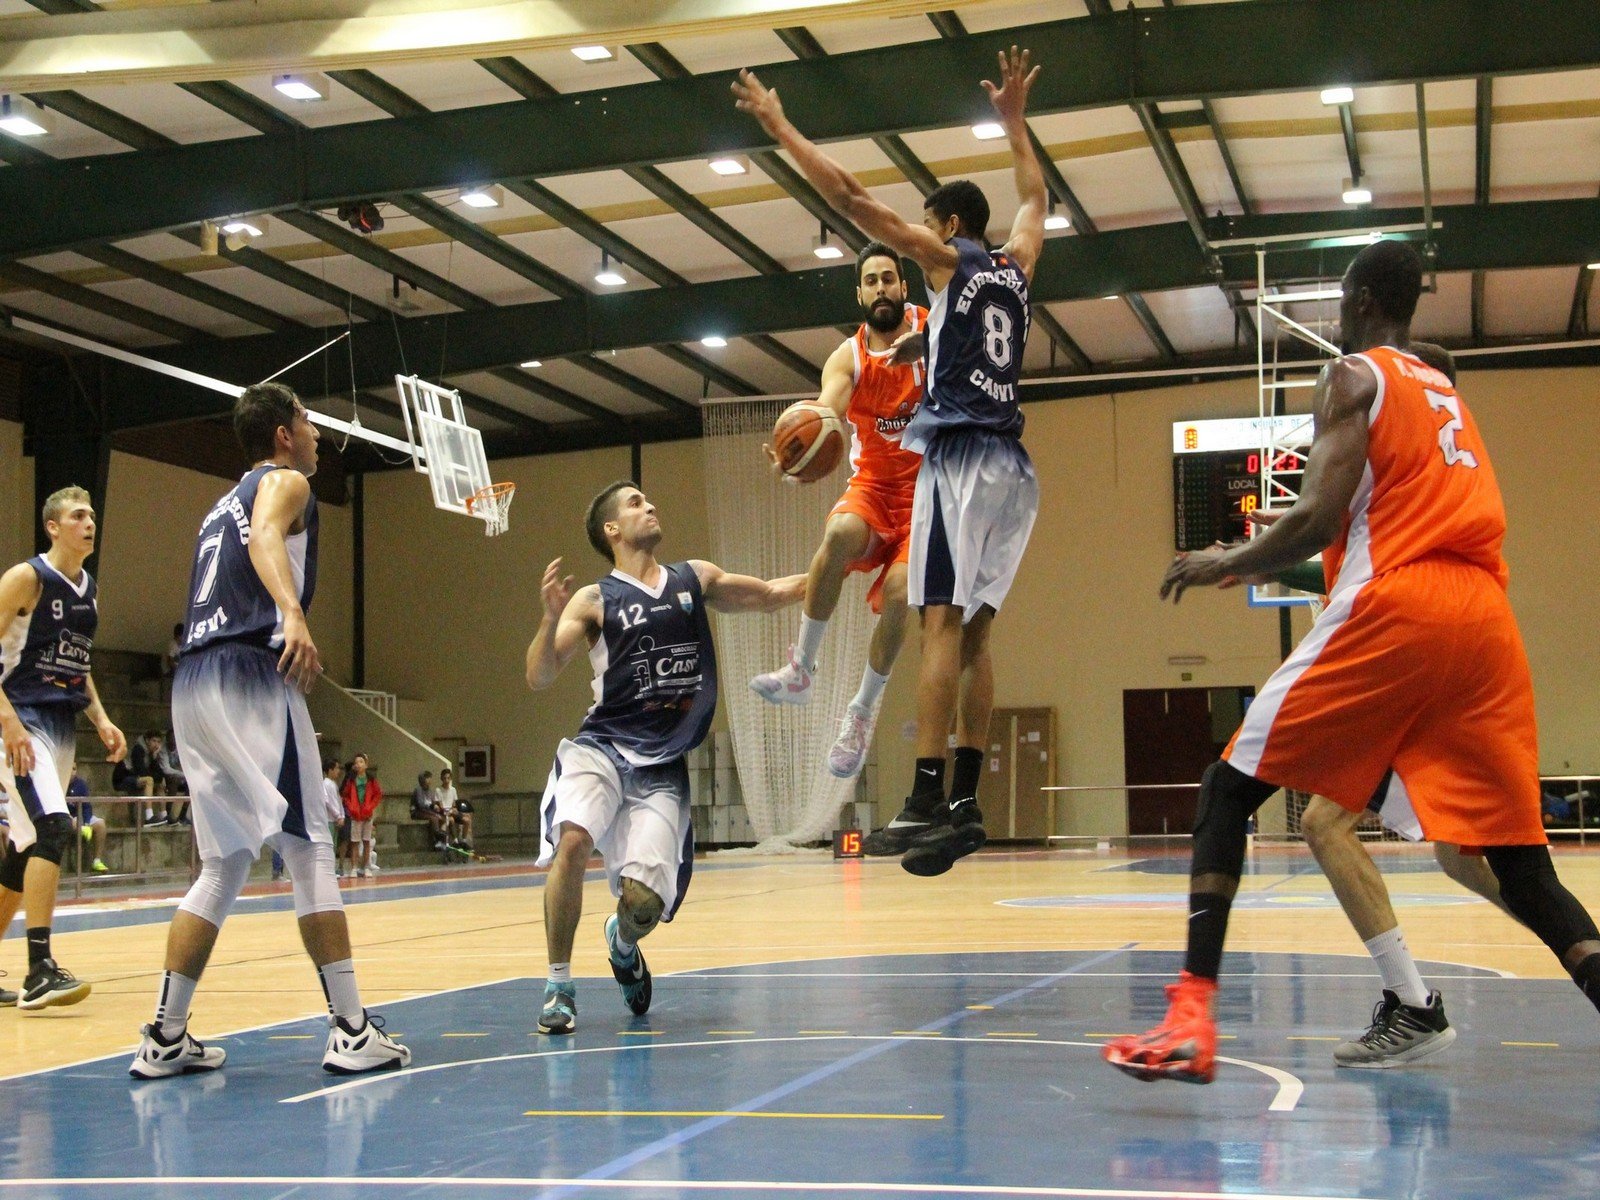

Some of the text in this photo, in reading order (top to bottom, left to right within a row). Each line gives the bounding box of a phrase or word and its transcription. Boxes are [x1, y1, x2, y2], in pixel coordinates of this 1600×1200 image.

[982, 301, 1013, 372] 8
[969, 368, 1015, 403] CASVI
[1423, 387, 1479, 469] 2
[1228, 479, 1258, 490] LOCAL
[1241, 494, 1257, 513] 18
[193, 525, 226, 608] 7
[51, 599, 64, 620] 9
[618, 603, 648, 631] 12
[842, 833, 860, 853] 15
